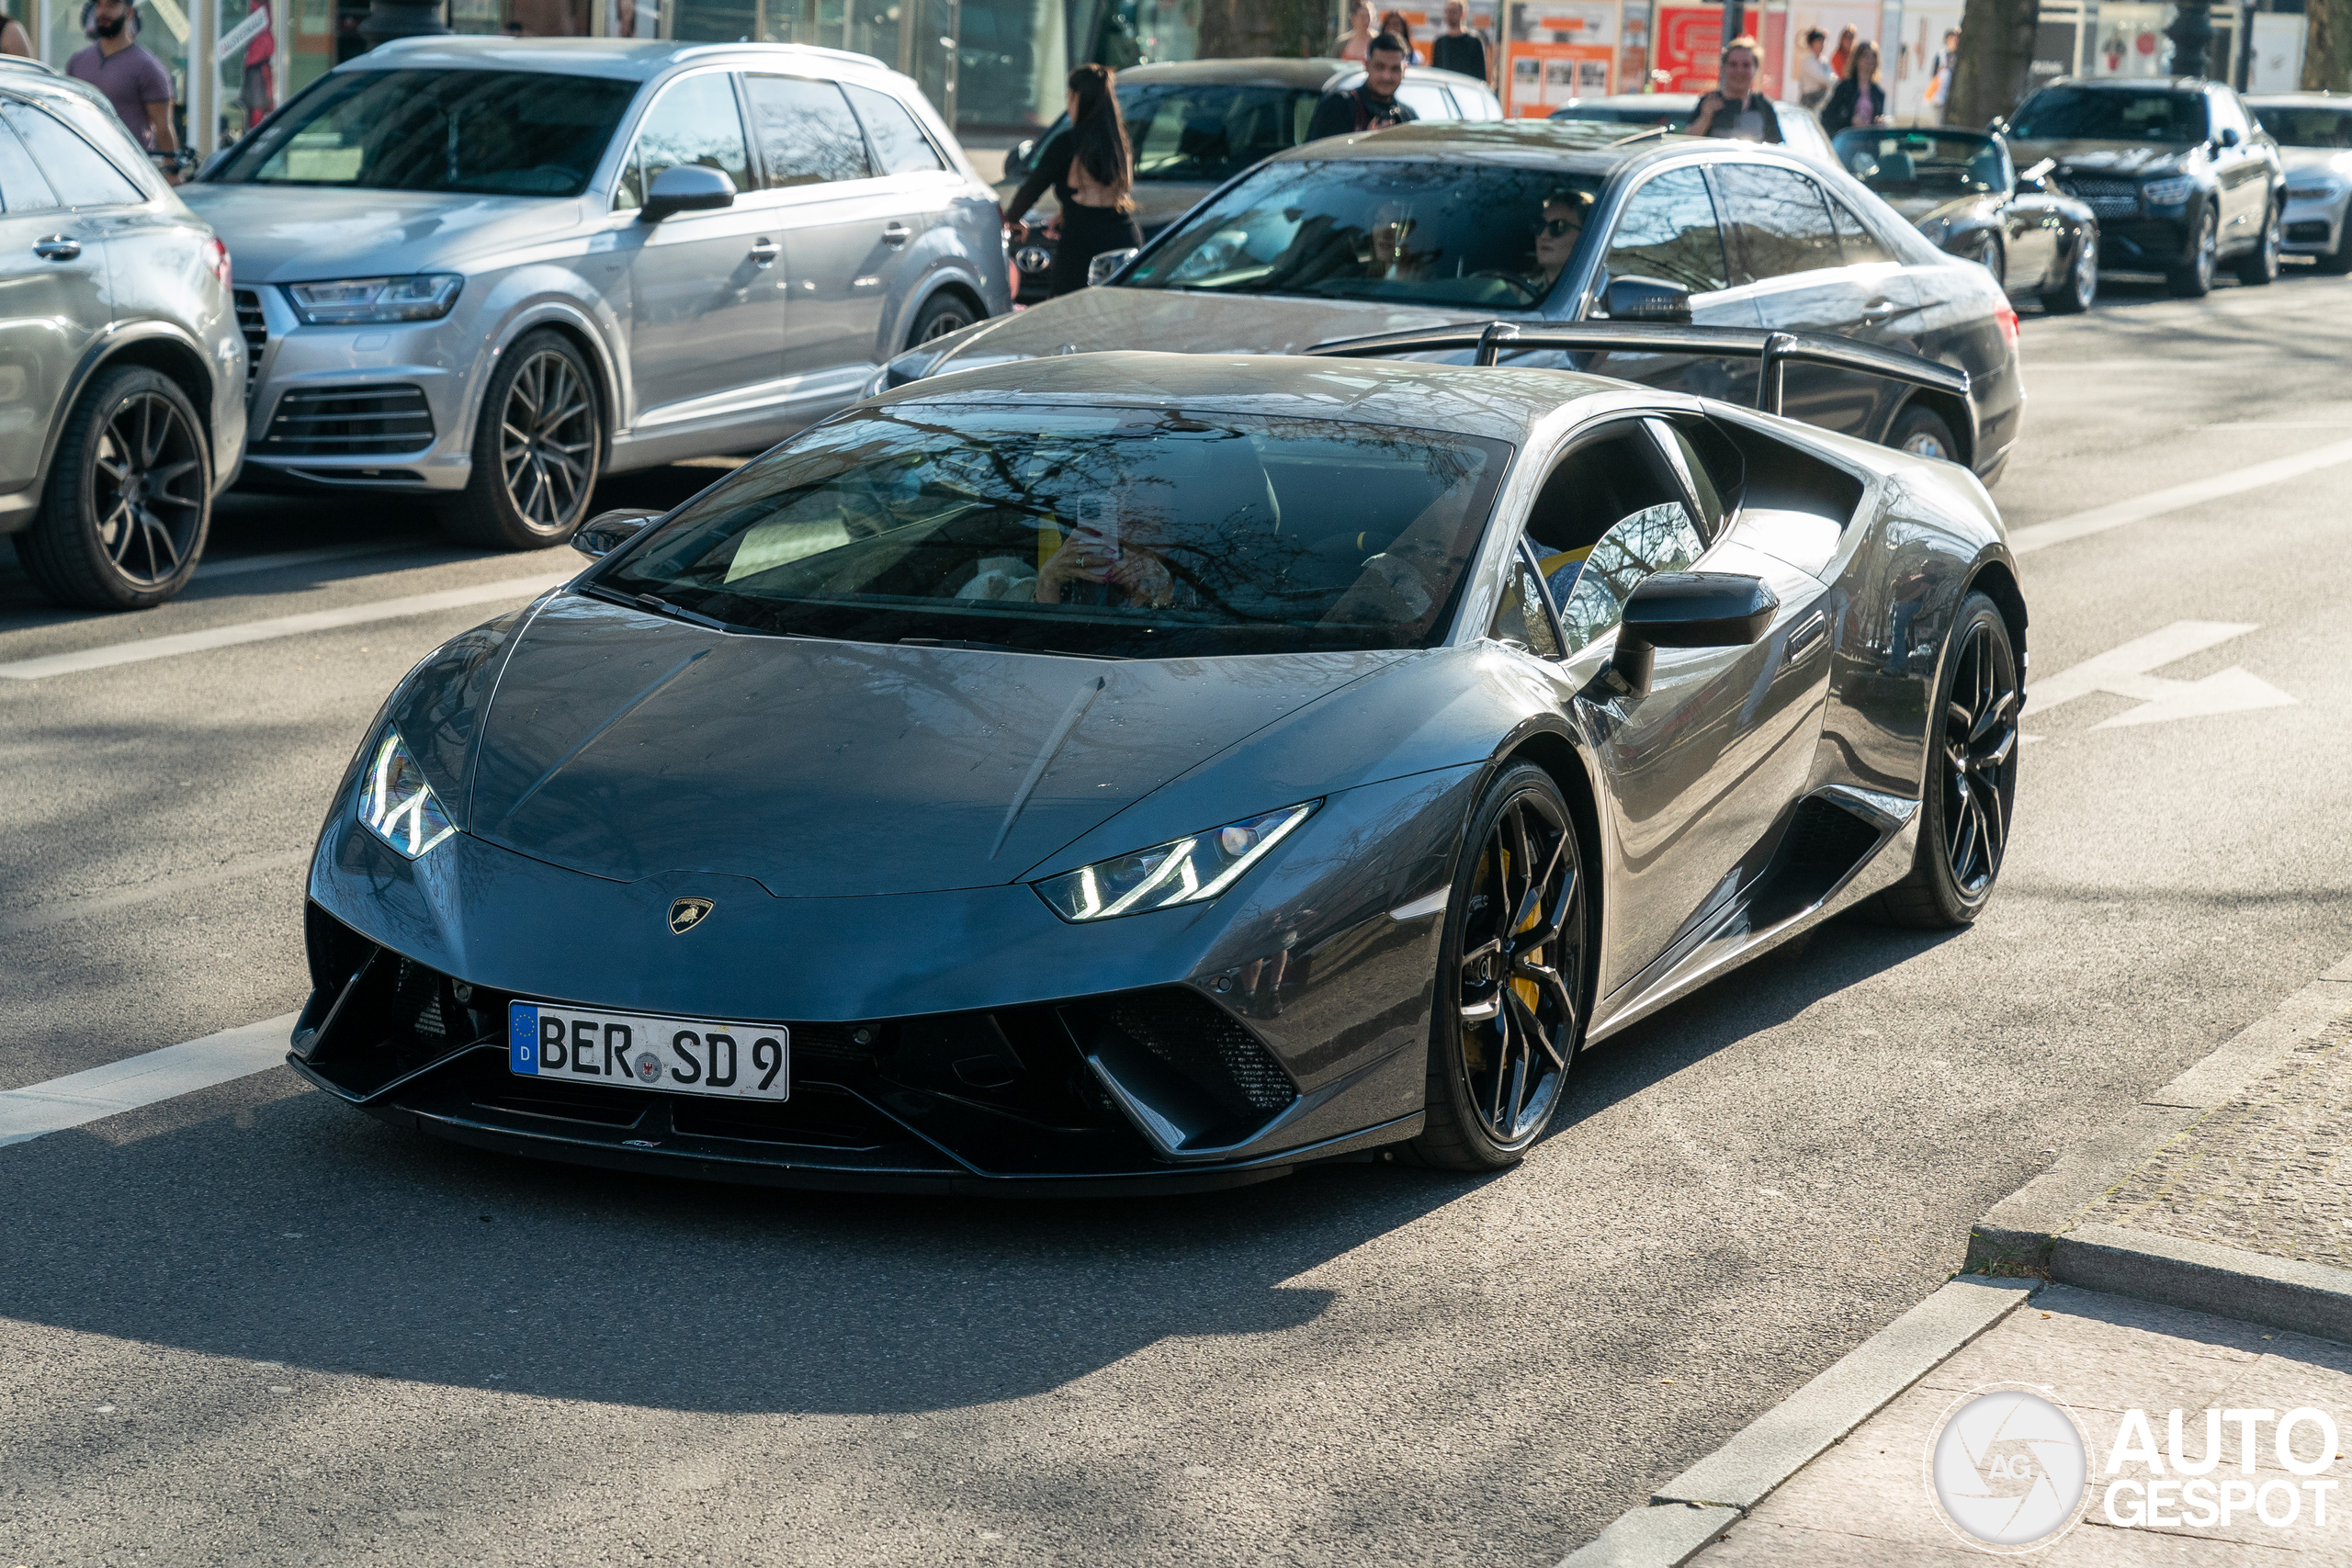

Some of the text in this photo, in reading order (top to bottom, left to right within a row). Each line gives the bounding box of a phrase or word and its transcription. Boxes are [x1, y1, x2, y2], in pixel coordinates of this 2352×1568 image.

[520, 1046, 530, 1061] D
[539, 1015, 634, 1078] BER
[671, 1029, 738, 1088] SD
[752, 1037, 783, 1090] 9
